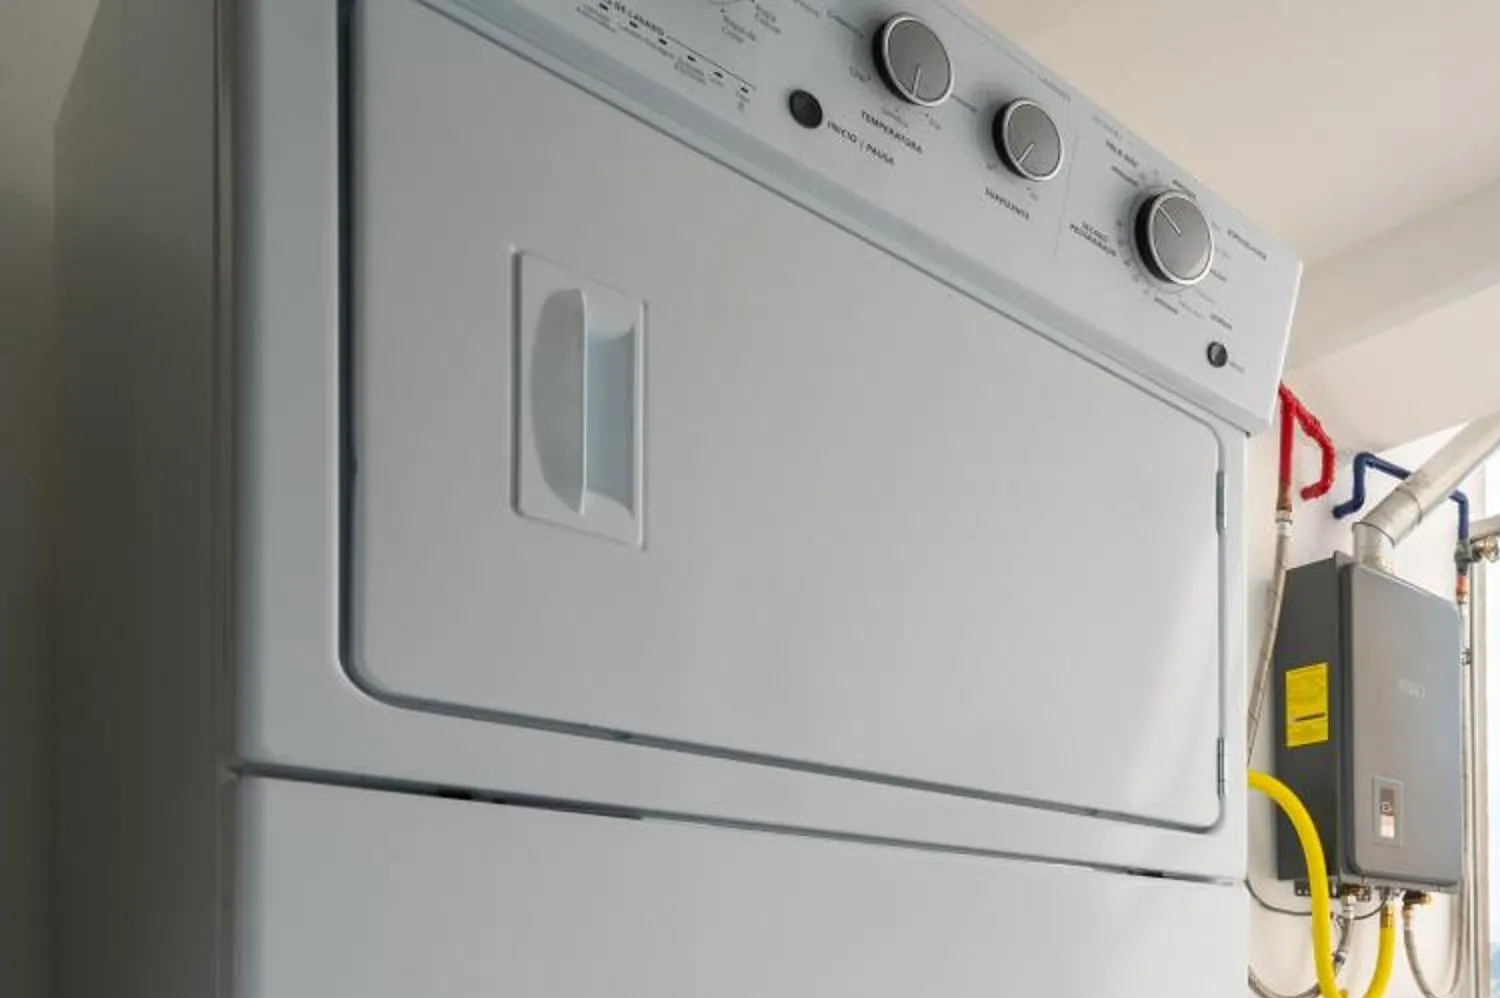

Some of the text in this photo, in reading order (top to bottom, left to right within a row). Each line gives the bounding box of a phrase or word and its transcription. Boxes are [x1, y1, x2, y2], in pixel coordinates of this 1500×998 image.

[827, 120, 858, 143] INICIO
[866, 143, 895, 166] PAUSA
[861, 109, 922, 154] TEMPERATURA
